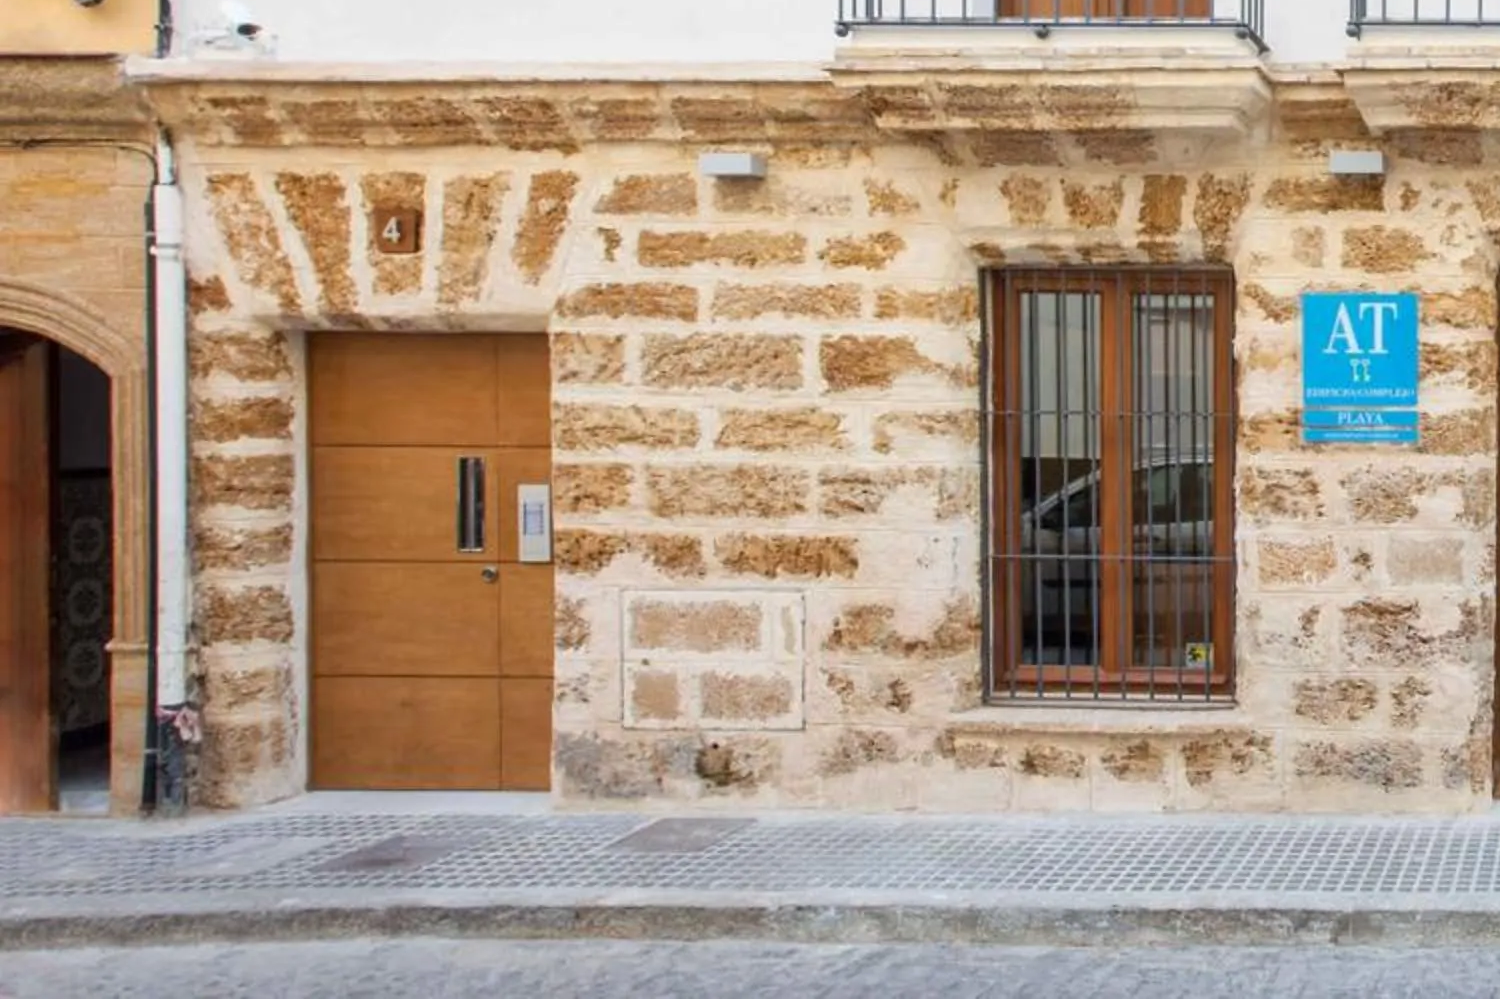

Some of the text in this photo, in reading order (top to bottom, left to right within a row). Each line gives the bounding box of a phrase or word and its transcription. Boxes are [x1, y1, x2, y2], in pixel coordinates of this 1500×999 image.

[382, 216, 401, 244] 4
[1322, 301, 1399, 355] AT
[1337, 411, 1384, 425] PLAYA
